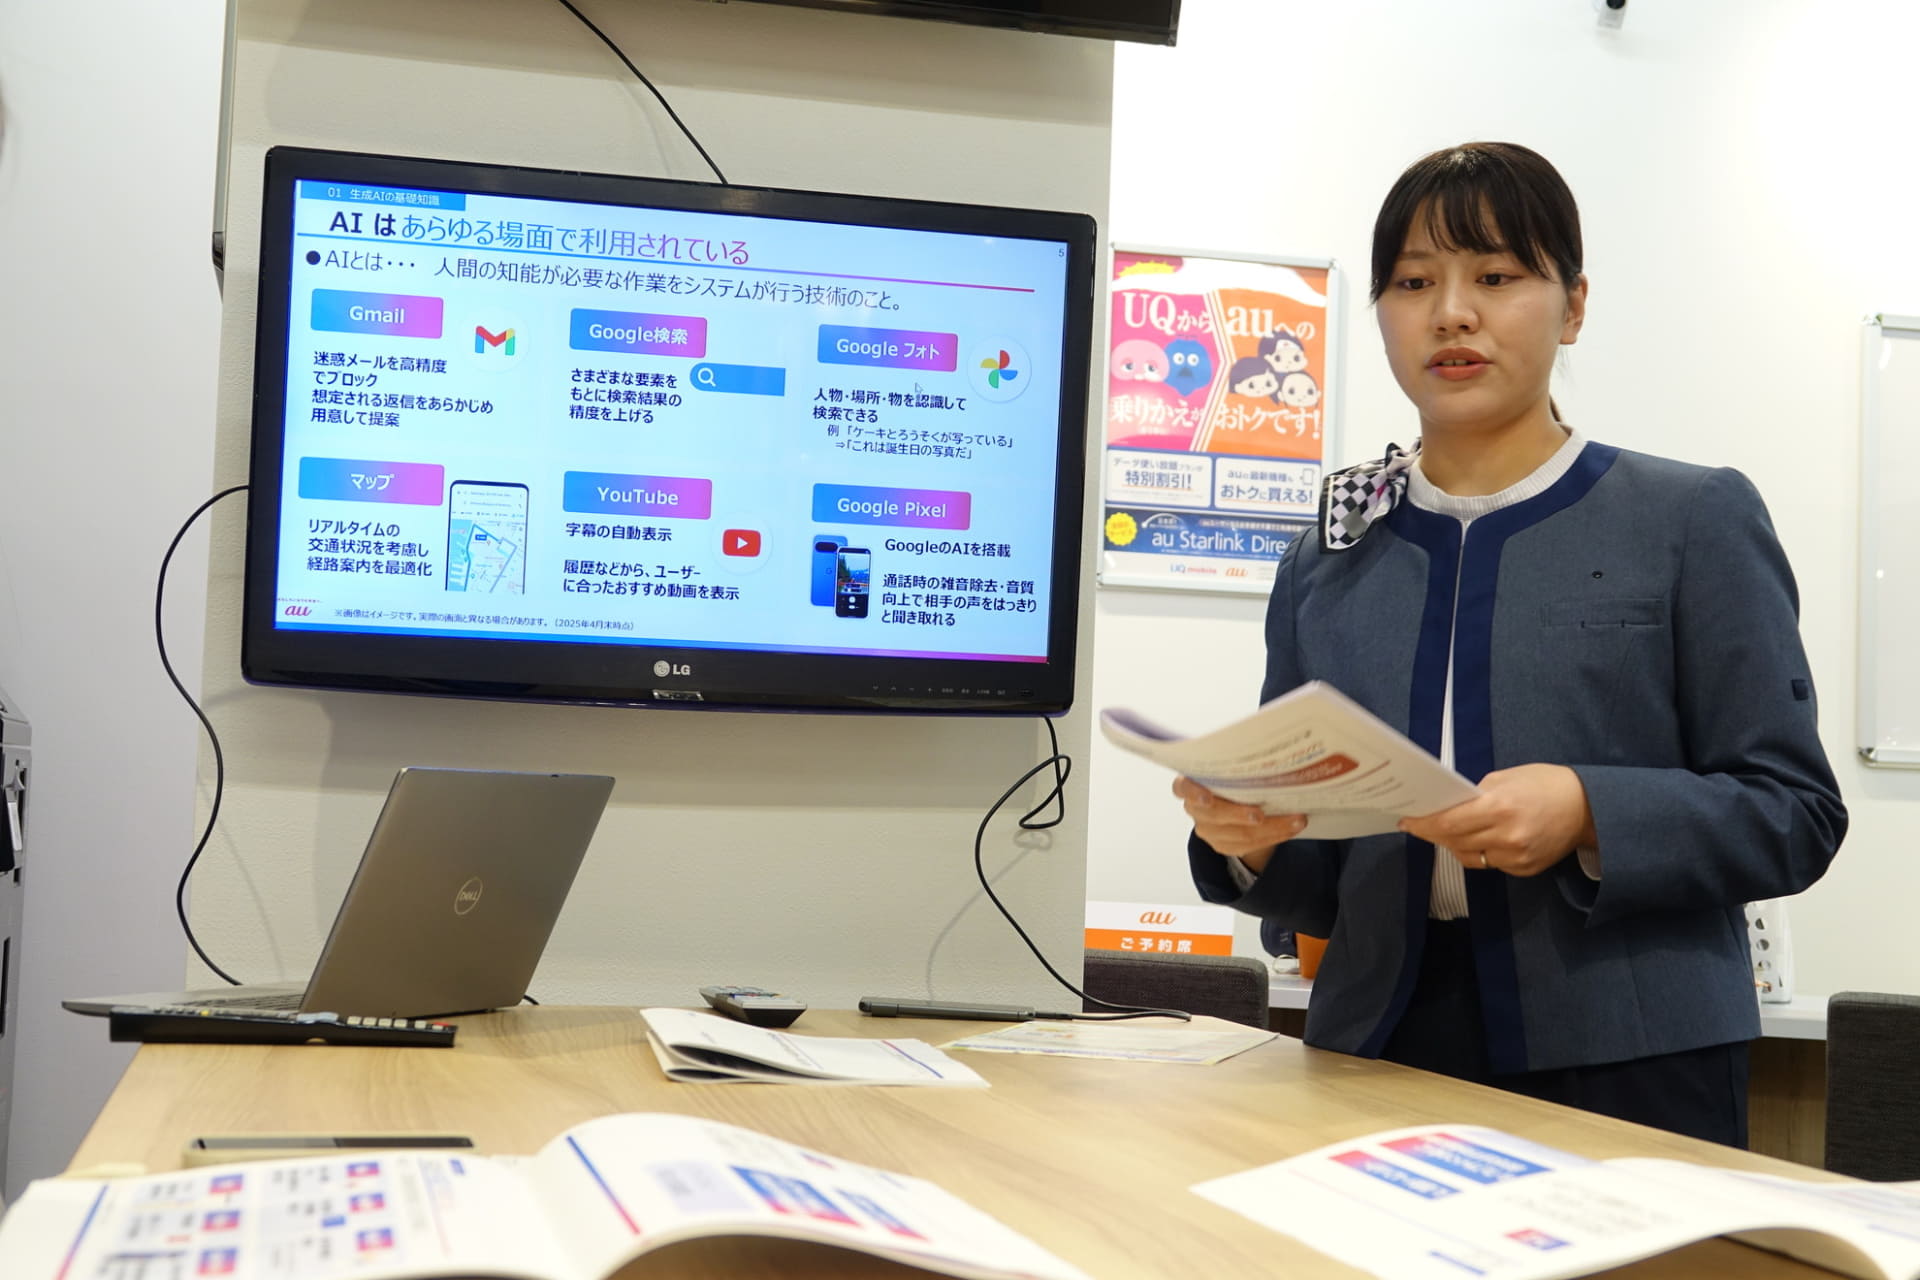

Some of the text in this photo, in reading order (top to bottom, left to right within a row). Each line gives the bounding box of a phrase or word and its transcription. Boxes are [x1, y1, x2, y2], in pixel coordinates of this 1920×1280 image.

[327, 187, 441, 206] 01 生成AIの基礎知識
[329, 211, 363, 234] AI
[1058, 248, 1065, 257] 5
[434, 257, 901, 311] 人間の知能が必要な作業をシステムが行う技術のこと。
[348, 305, 406, 325] Gmail
[1227, 305, 1316, 341] auへの
[588, 325, 688, 347] Google検索
[836, 338, 940, 360] Google フォト
[313, 351, 448, 374] 迷惑メールを高精度
[313, 370, 379, 388] でブロック
[570, 368, 679, 390] さまざまな要素を
[312, 389, 494, 415] 想定される返信をあらかじめ
[570, 386, 683, 408] もとに検索結果の
[813, 387, 968, 411] 人物・場所・物を認識して
[310, 407, 401, 428] 用意して提案
[569, 404, 655, 424] 精度を上げる
[812, 406, 879, 424] 検索できる
[827, 424, 840, 437] 例
[350, 473, 395, 491] マップ
[597, 486, 680, 505] YouTube
[837, 498, 947, 518] Google Pixel
[308, 519, 400, 537] リアルタイムの
[565, 522, 672, 542] 字幕の自動表示
[307, 538, 430, 558] 交通状況を考慮し
[885, 538, 1012, 558] GoogleのAIを搭載
[1151, 531, 1174, 547] au
[1179, 530, 1245, 552] Starlink
[306, 557, 433, 577] 経路案内を最適化
[563, 559, 702, 580] 履歴などから、ユーザー
[562, 578, 741, 601] に合ったおすすめ動画を表示
[882, 573, 1035, 595] 通話時の雑音除去・音質
[284, 605, 312, 617] au
[881, 592, 1037, 613] 向上で相手の声をはっきり
[881, 609, 956, 627] と聞き取れる
[672, 663, 691, 676] LG
[459, 889, 478, 902] DELL
[1139, 911, 1177, 925] au
[1120, 937, 1193, 954] ご予約席
